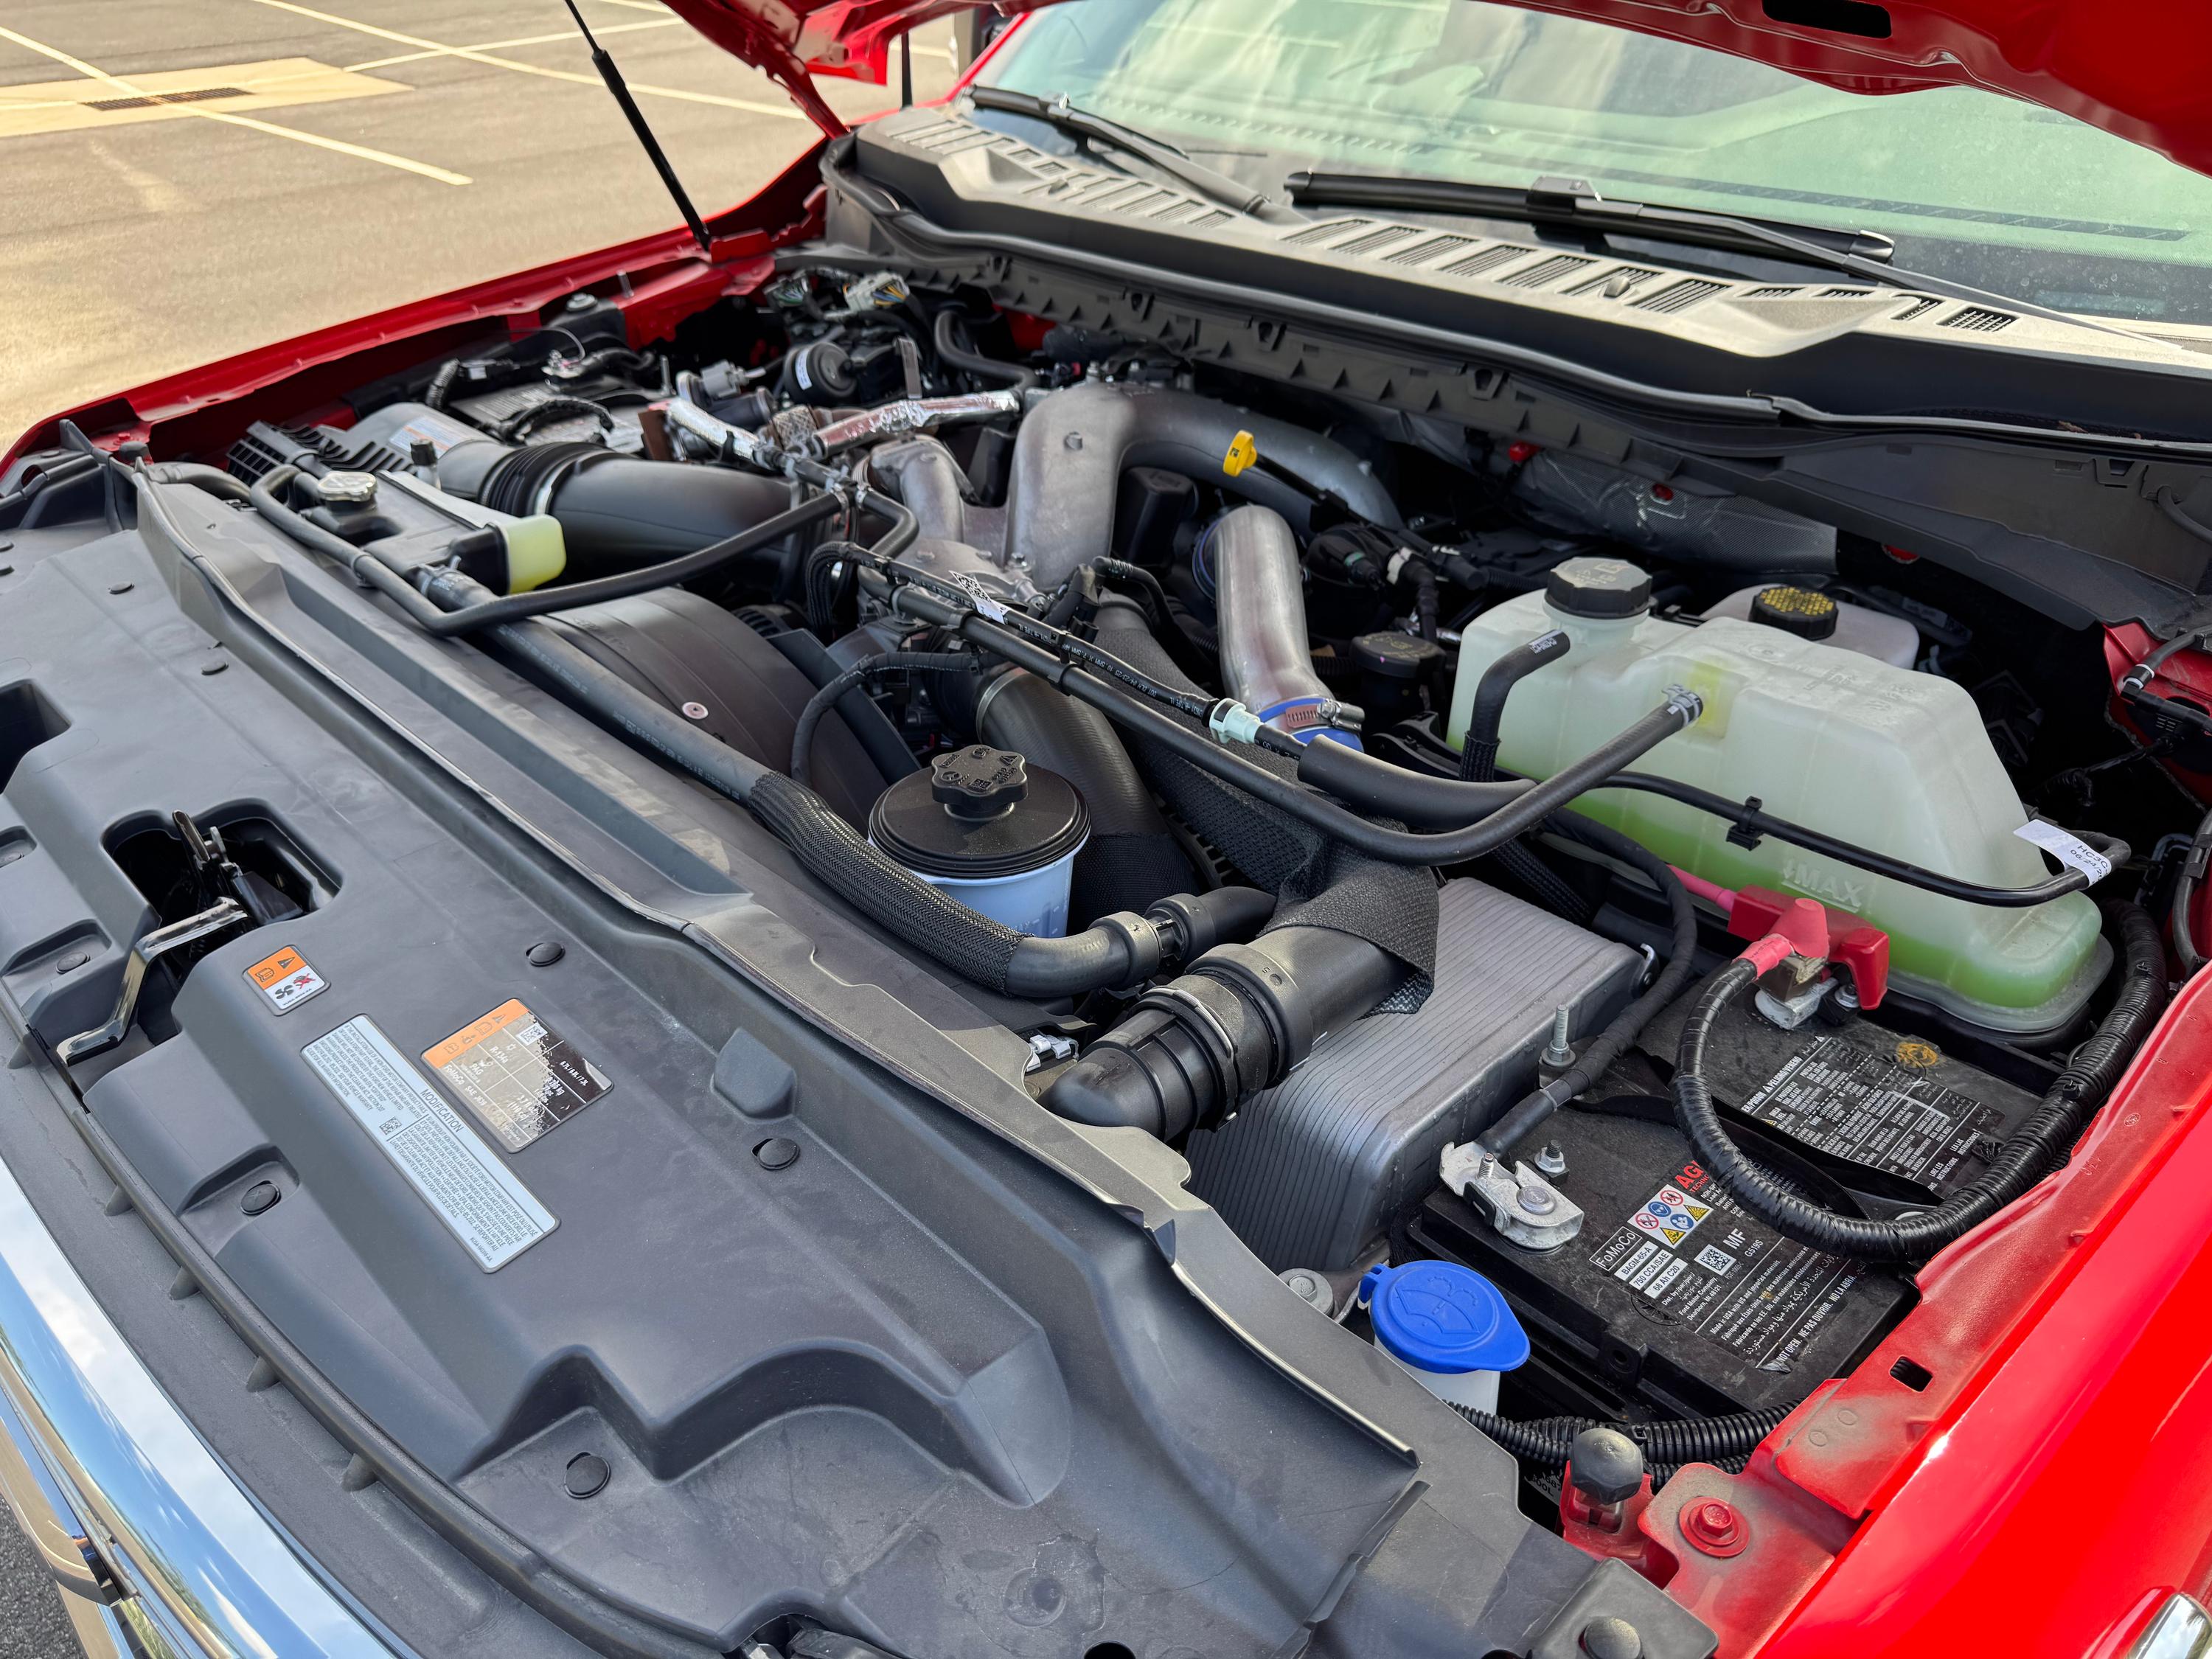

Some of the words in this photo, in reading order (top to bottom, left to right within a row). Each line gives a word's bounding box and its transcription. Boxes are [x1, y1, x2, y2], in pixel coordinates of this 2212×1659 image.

[1794, 861, 1865, 908] MAX
[489, 1045, 510, 1064] R-134a
[443, 1063, 466, 1085] FoMoCo
[464, 1085, 477, 1096] SAE
[468, 1062, 484, 1076] PAG
[420, 1088, 464, 1133] MODIFICATION
[1739, 1091, 1768, 1112] ER/POISON
[1593, 1230, 1638, 1267] FoMoCo
[1722, 1228, 1749, 1250] MF
[1743, 1238, 1764, 1258] G519S
[1620, 1245, 1653, 1275] BAGM-65-A
[1632, 1274, 1647, 1287] 750
[1641, 1251, 1670, 1277] CCA/SAE
[1785, 1248, 1806, 1269] américains
[1652, 1282, 1663, 1291] 68
[1658, 1275, 1670, 1284] Ah
[1666, 1264, 1680, 1277] C20
[1770, 1266, 1790, 1285] matériaux
[1709, 1321, 1723, 1335] Made
[1722, 1310, 1734, 1320] USA
[1729, 1301, 1741, 1312] with
[1736, 1295, 1746, 1304] US
[1742, 1289, 1753, 1298] and
[1748, 1274, 1767, 1293] imported
[1762, 1257, 1782, 1277] materials.
[1764, 1282, 1775, 1292] des
[1787, 1279, 1813, 1303] الأمريكية
[1661, 1294, 1674, 1305] Dist.
[1677, 1304, 1690, 1315] Ford
[1686, 1293, 1701, 1307] Motor
[1686, 1299, 1708, 1321] Dearborn,
[1739, 1296, 1761, 1318] États-Unis
[1753, 1315, 1763, 1323] los
[1771, 1295, 1781, 1304] con
[1776, 1276, 1797, 1297] materiales
[1780, 1298, 1797, 1314] بمواد
[1735, 1315, 1745, 1325] aux
[1771, 1309, 1787, 1323] منها
[1784, 1335, 1803, 1354] OPEN.
[1797, 1327, 1810, 1338] NE
[1804, 1318, 1818, 1331] PAS
[1811, 1299, 1834, 1322] OUVRIR.
[1828, 1292, 1840, 1302] NO
[1834, 1285, 1846, 1295] LA
[1720, 1321, 1740, 1341] Fabriqué
[1742, 1332, 1767, 1356] مستوردة
